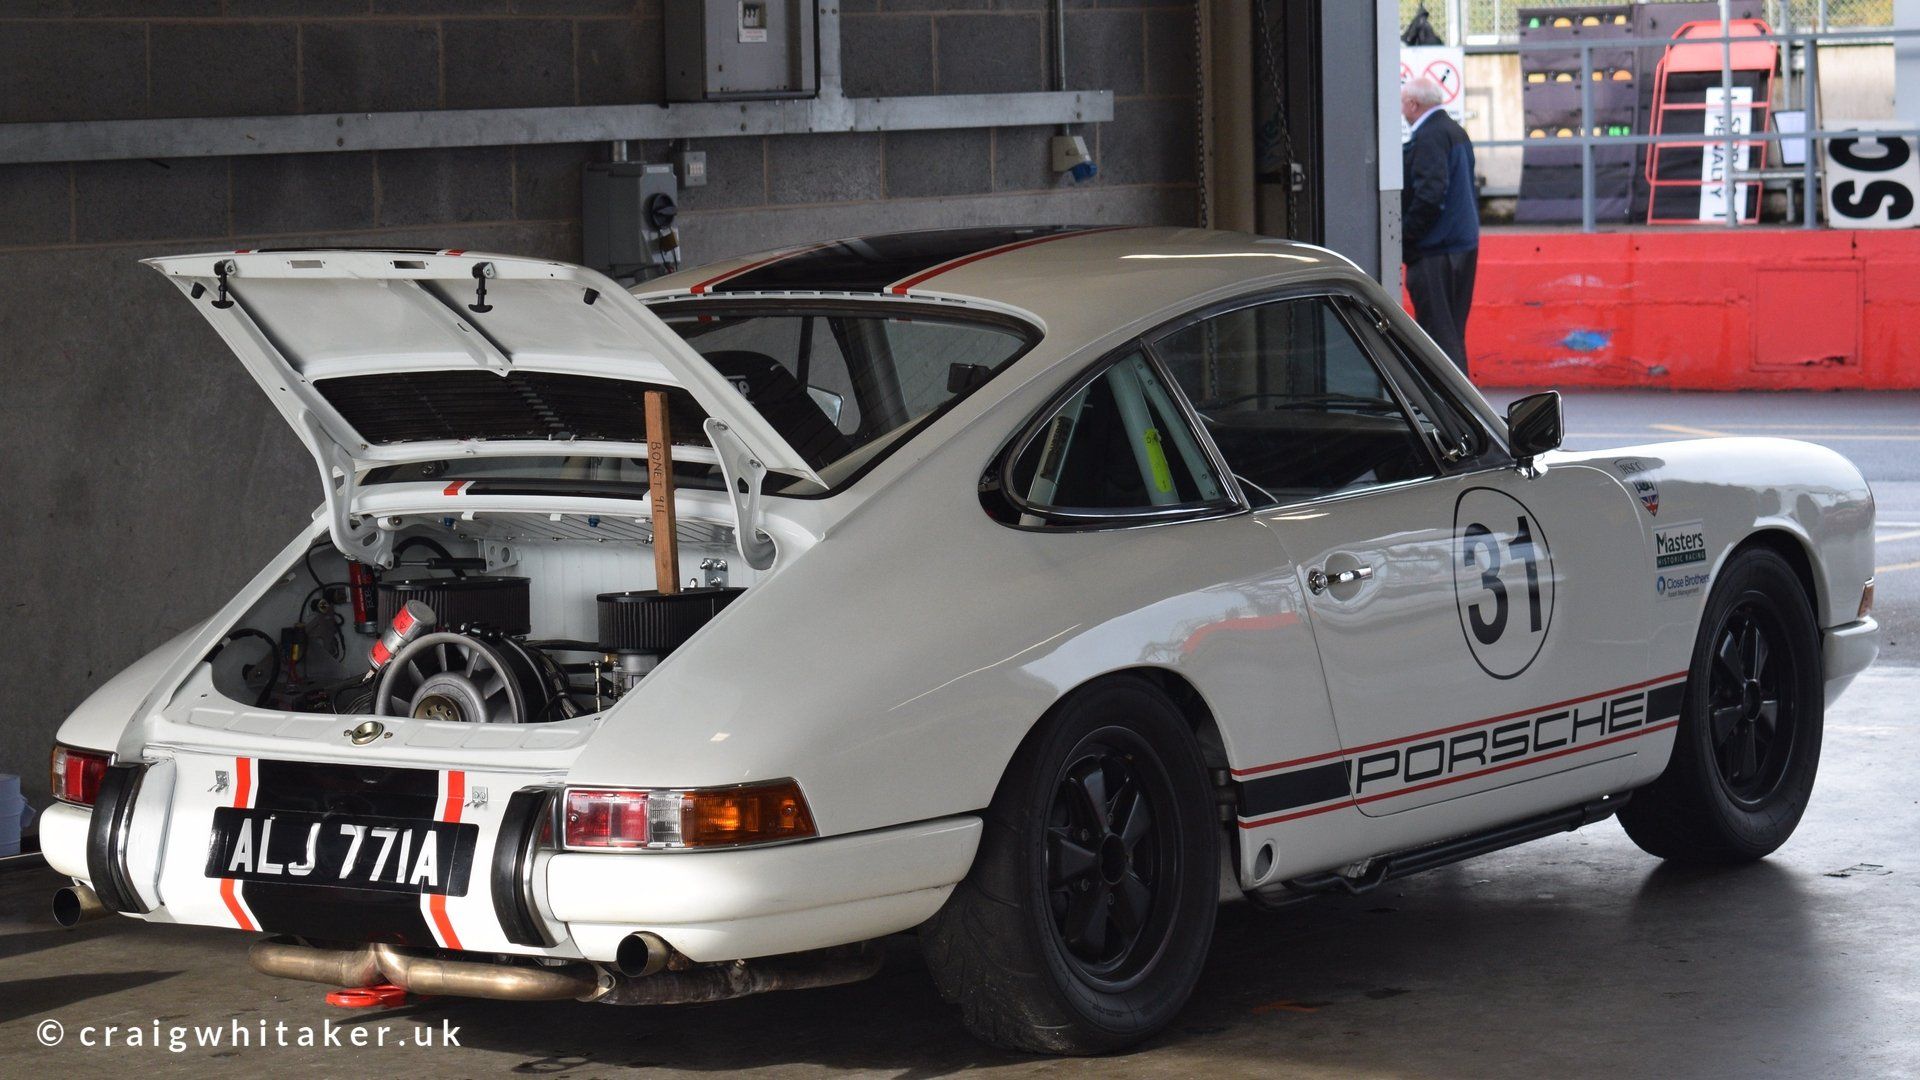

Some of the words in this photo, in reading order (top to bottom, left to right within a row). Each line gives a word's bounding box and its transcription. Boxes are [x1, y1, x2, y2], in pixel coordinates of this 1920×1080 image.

[1828, 128, 1914, 221] SC
[651, 441, 663, 489] BONET
[655, 495, 665, 513] 911
[1656, 531, 1704, 554] Masters
[1658, 554, 1685, 566] HISTORIC
[1686, 549, 1706, 561] RACING
[1464, 516, 1542, 645] 31
[1667, 578, 1683, 589] Close
[1685, 574, 1710, 586] Brothers
[1356, 692, 1645, 794] PORSCHE
[229, 818, 321, 876] ALJ
[339, 823, 439, 886] 771A
